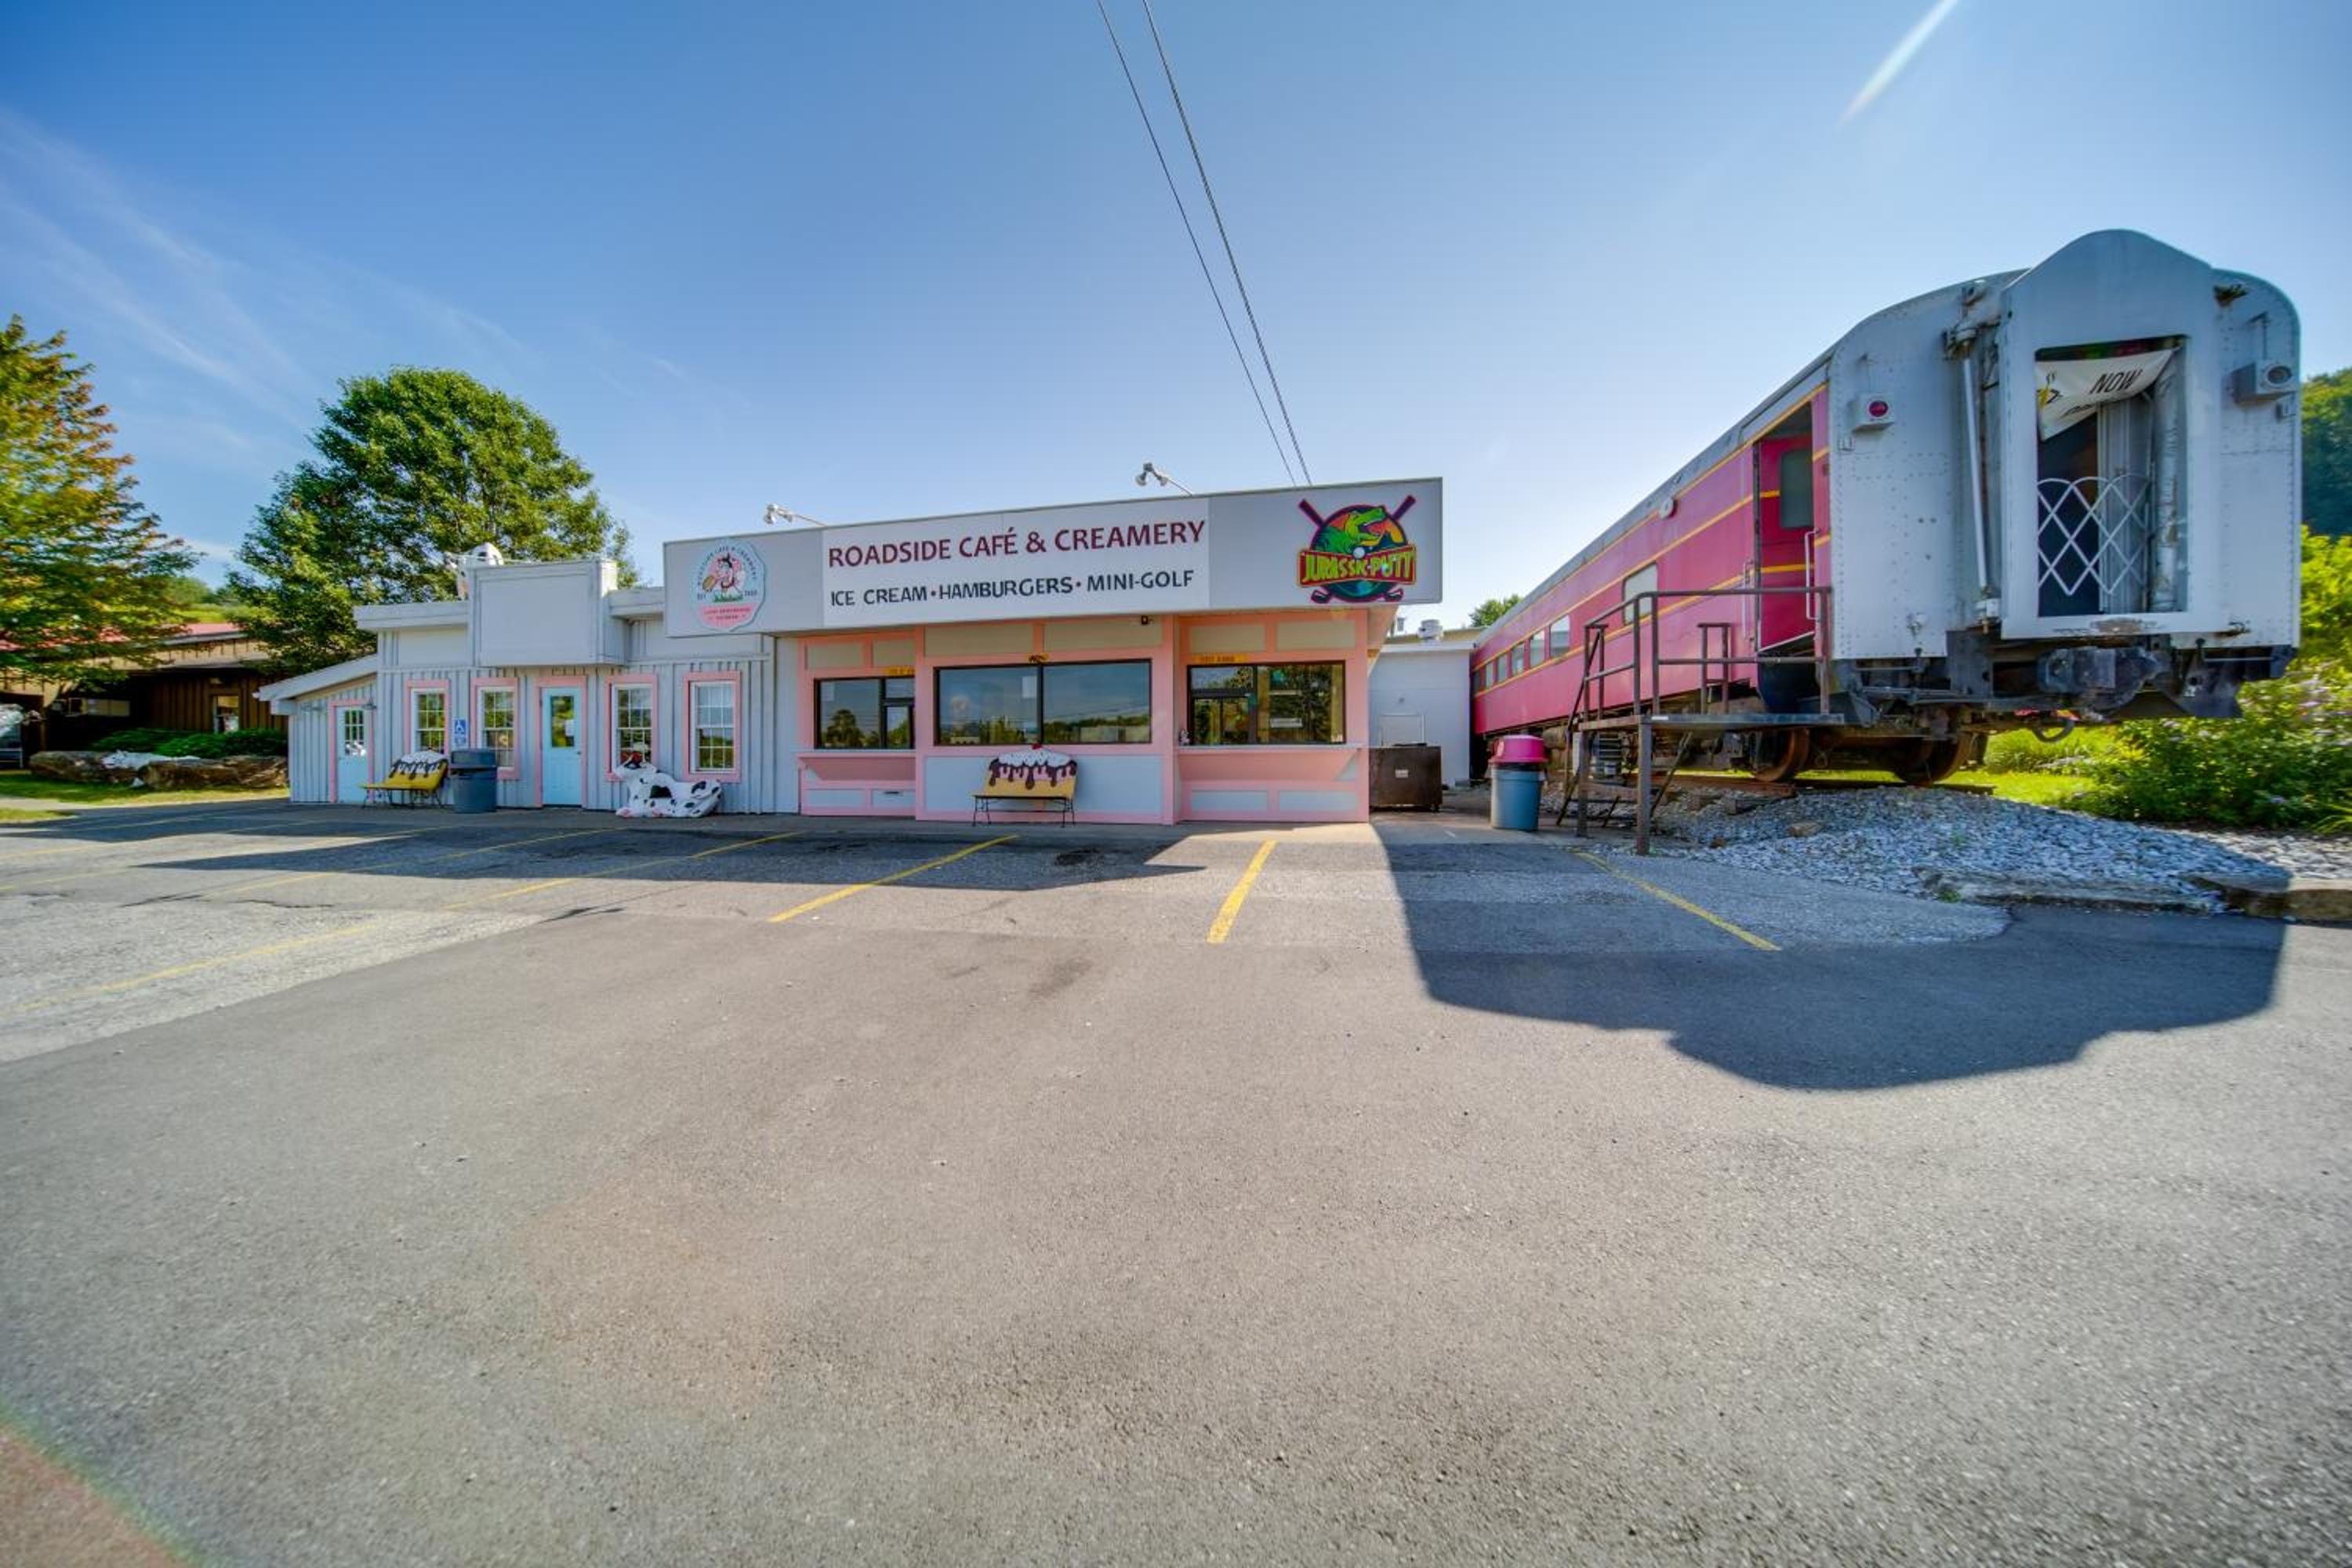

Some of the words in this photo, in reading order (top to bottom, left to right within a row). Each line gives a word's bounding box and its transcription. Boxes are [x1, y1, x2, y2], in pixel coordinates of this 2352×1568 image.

[2089, 368, 2143, 395] NOW
[829, 539, 951, 568] ROADSIDE
[959, 527, 1018, 557] CAFÉ
[1025, 531, 1047, 554] &
[1054, 521, 1205, 552] CREAMERY
[1304, 554, 1368, 582] JURASSIC
[1370, 550, 1412, 579] PUTT
[831, 590, 855, 606] ICE
[863, 586, 927, 605] CREAM
[940, 577, 1073, 600] HAMBURGERS
[1087, 570, 1194, 592] MINI-GOLF
